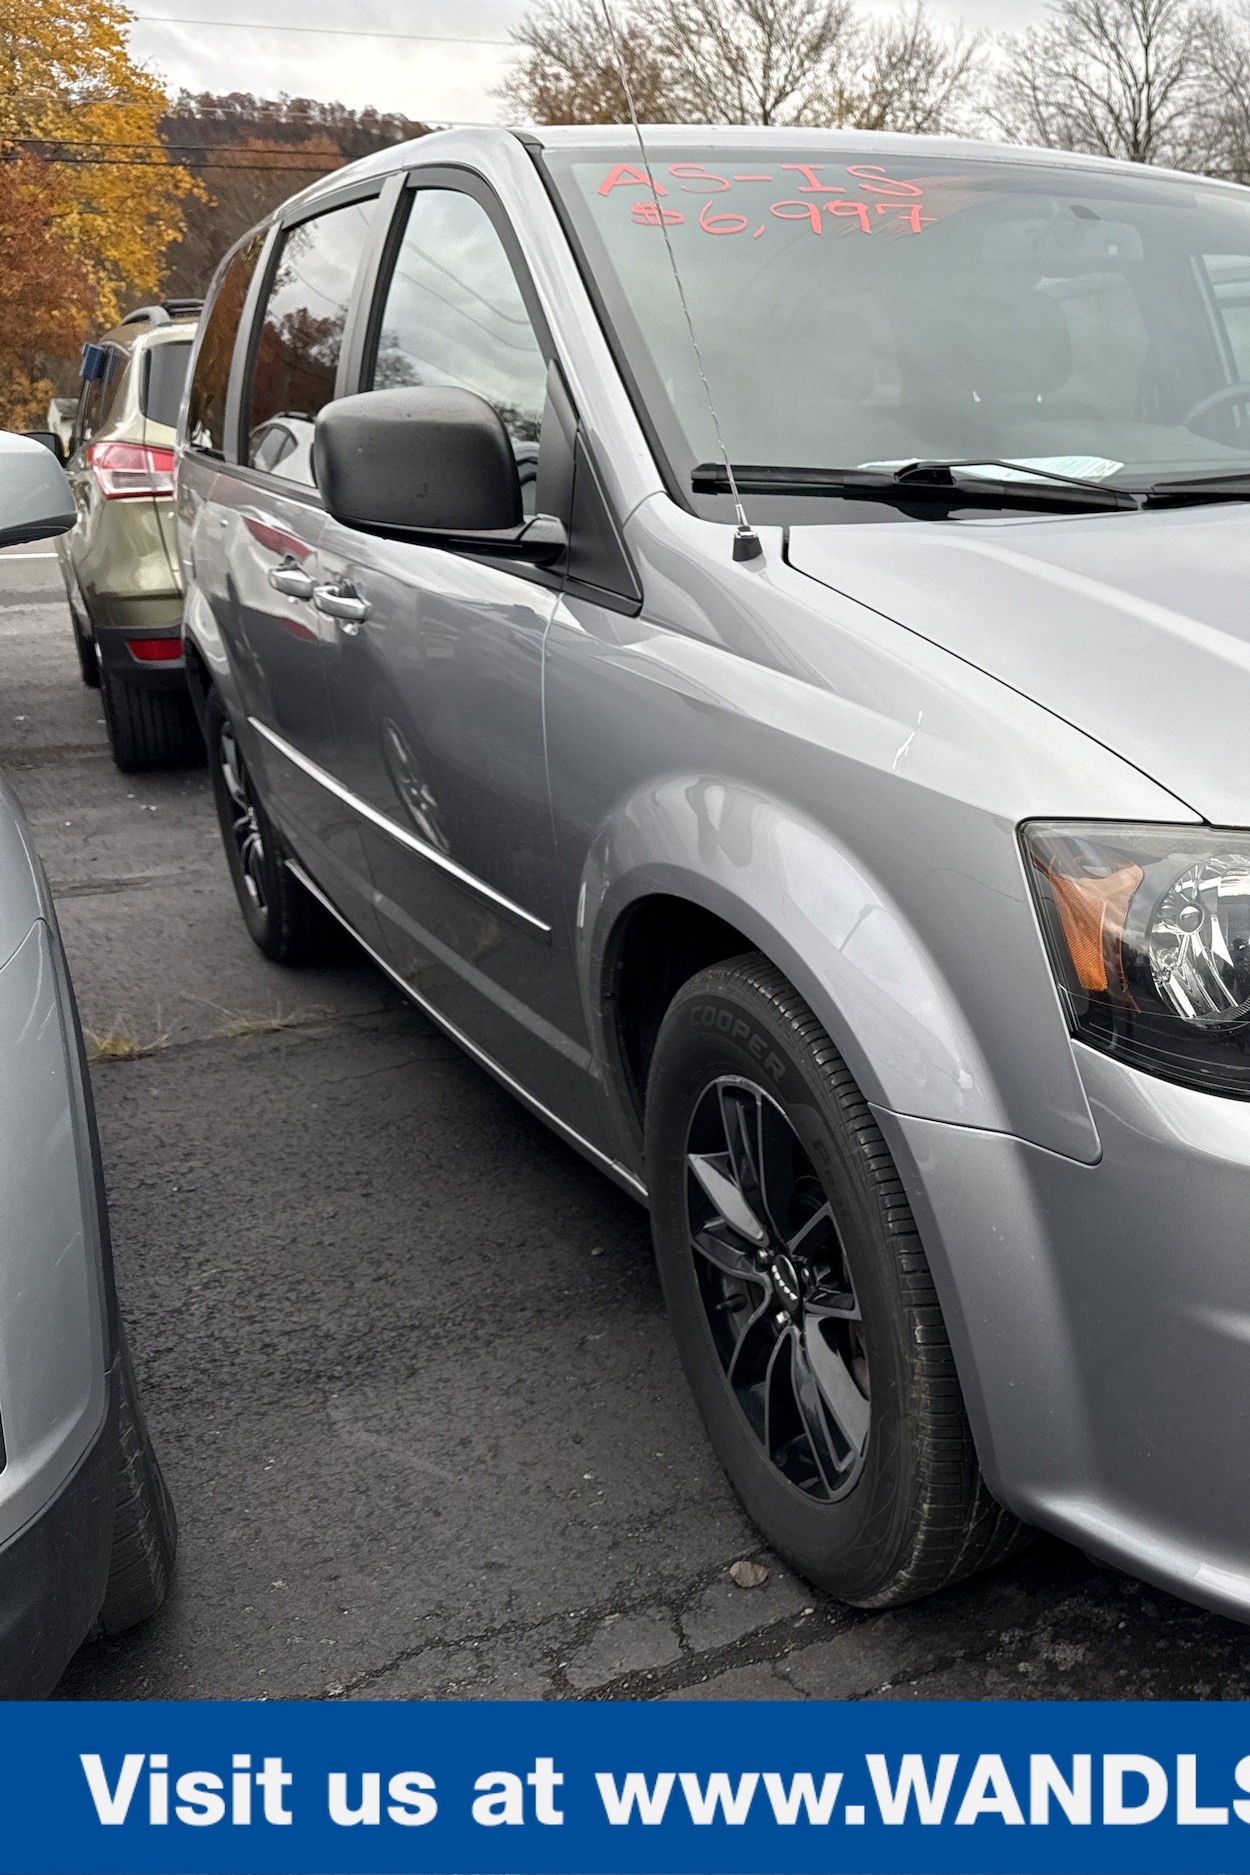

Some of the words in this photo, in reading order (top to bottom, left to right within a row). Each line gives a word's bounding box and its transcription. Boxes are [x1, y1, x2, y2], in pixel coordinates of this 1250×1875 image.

[597, 163, 923, 197] AS-IS
[631, 200, 937, 239] $6,997
[690, 1005, 786, 1083] COOPER
